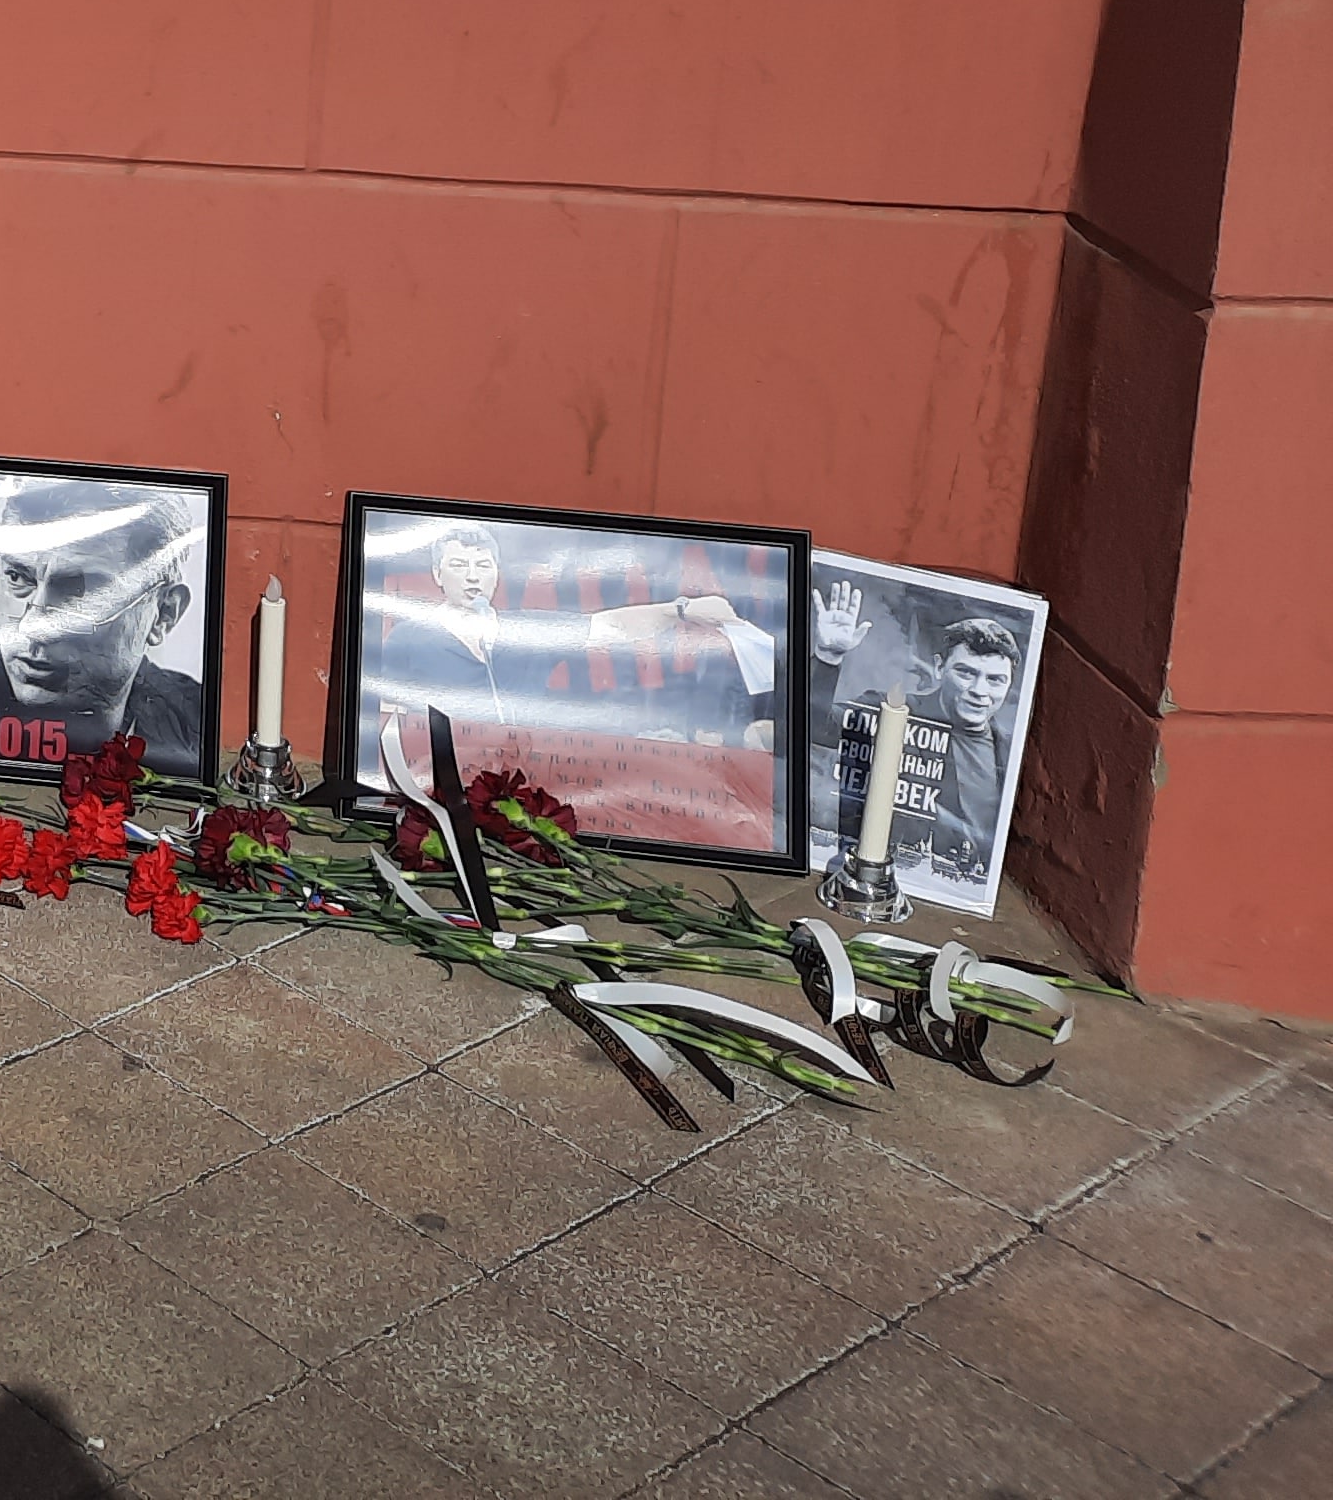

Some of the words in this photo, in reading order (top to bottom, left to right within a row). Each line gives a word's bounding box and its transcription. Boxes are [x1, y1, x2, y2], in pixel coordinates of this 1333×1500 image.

[842, 708, 950, 754] СЛИКОМ
[838, 738, 945, 781] СВОНЫЙ
[833, 762, 941, 814] ЧЕВЕК
